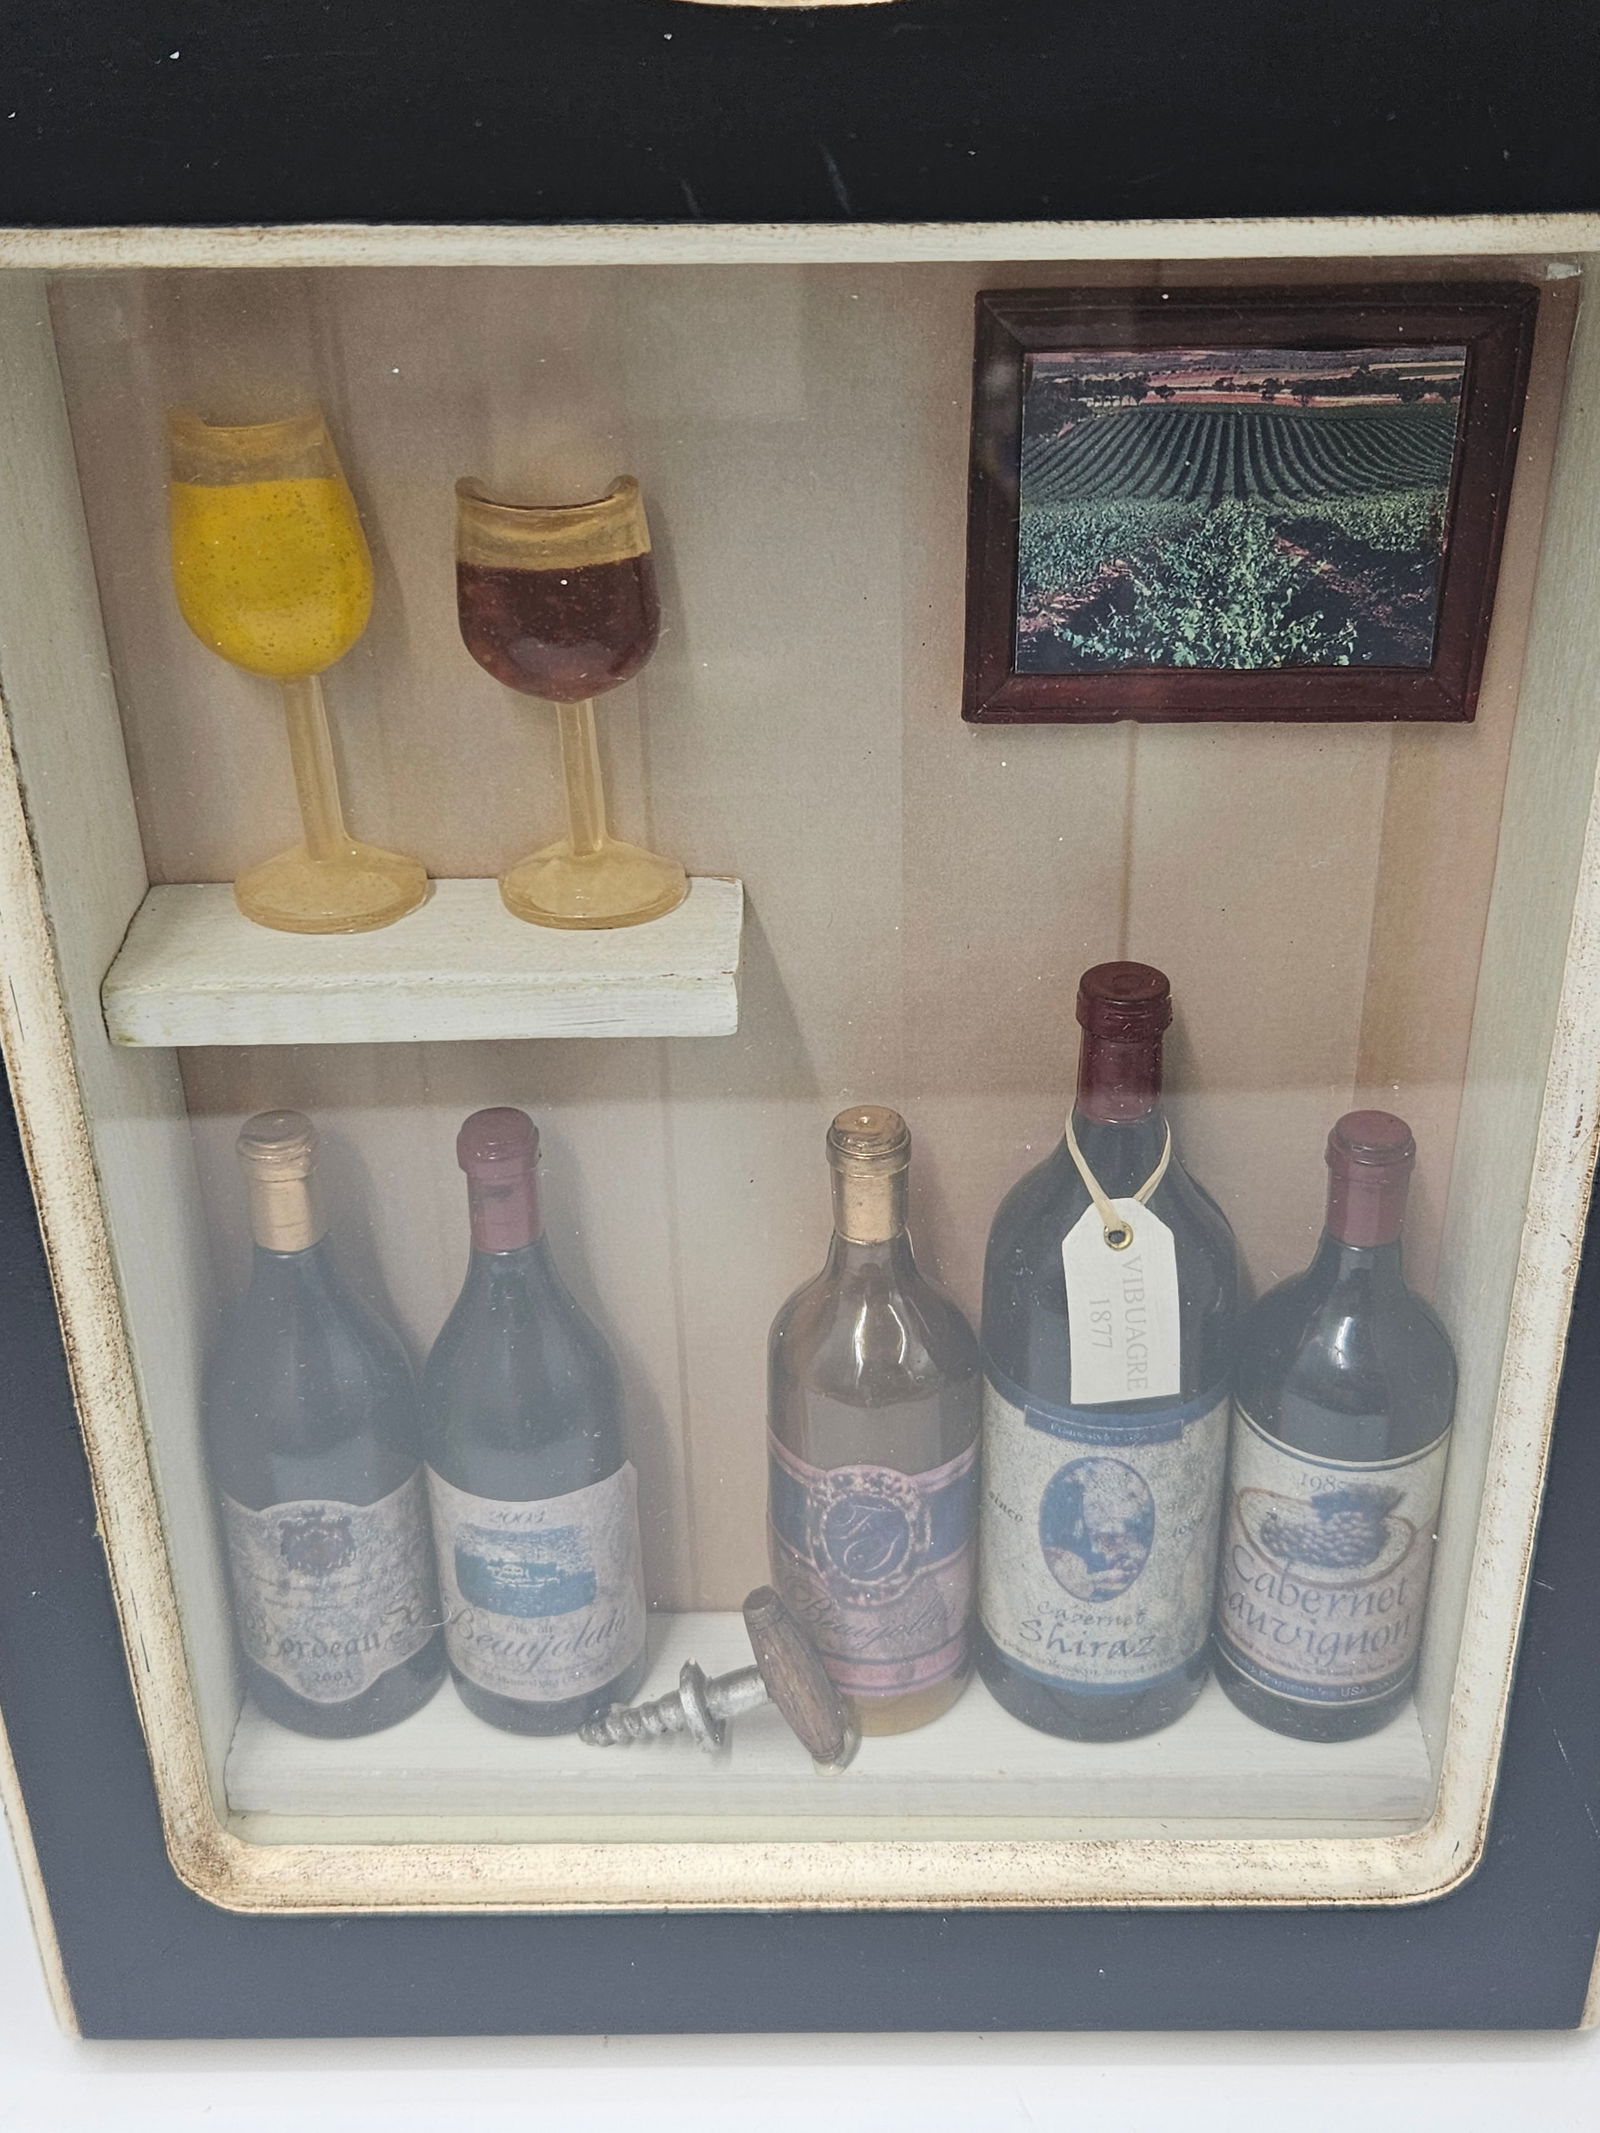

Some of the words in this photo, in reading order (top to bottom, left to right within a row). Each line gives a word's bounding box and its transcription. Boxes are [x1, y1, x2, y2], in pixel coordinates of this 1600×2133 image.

[1088, 1298, 1113, 1349] 1877
[1121, 1254, 1149, 1392] VIBUAGRE
[1232, 1543, 1408, 1616] Cabernet
[1018, 1617, 1156, 1660] Shiraz
